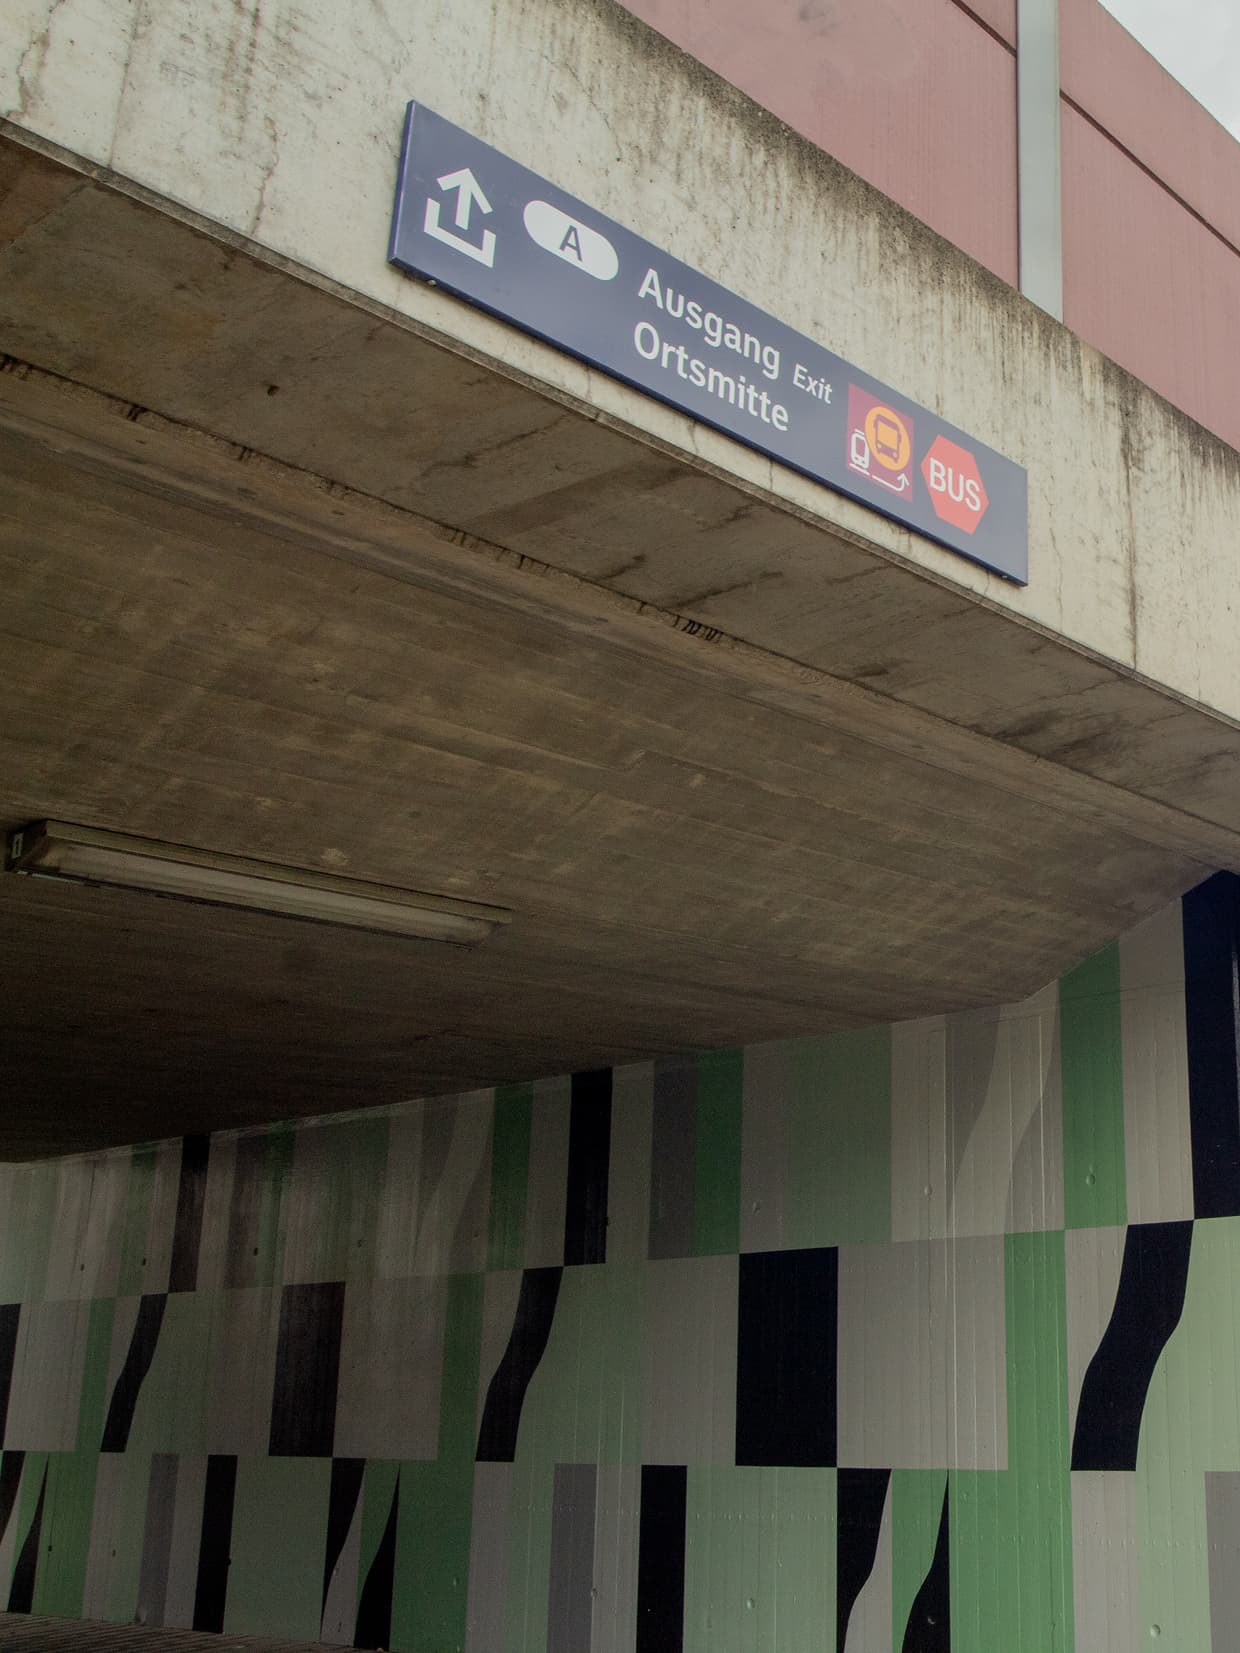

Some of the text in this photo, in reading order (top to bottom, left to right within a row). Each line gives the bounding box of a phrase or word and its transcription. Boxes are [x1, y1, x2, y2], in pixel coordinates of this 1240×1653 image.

[559, 225, 584, 262] A
[633, 320, 791, 433] Ortsmitte
[637, 267, 833, 405] Ausgang Exit
[929, 456, 982, 512] BUS
